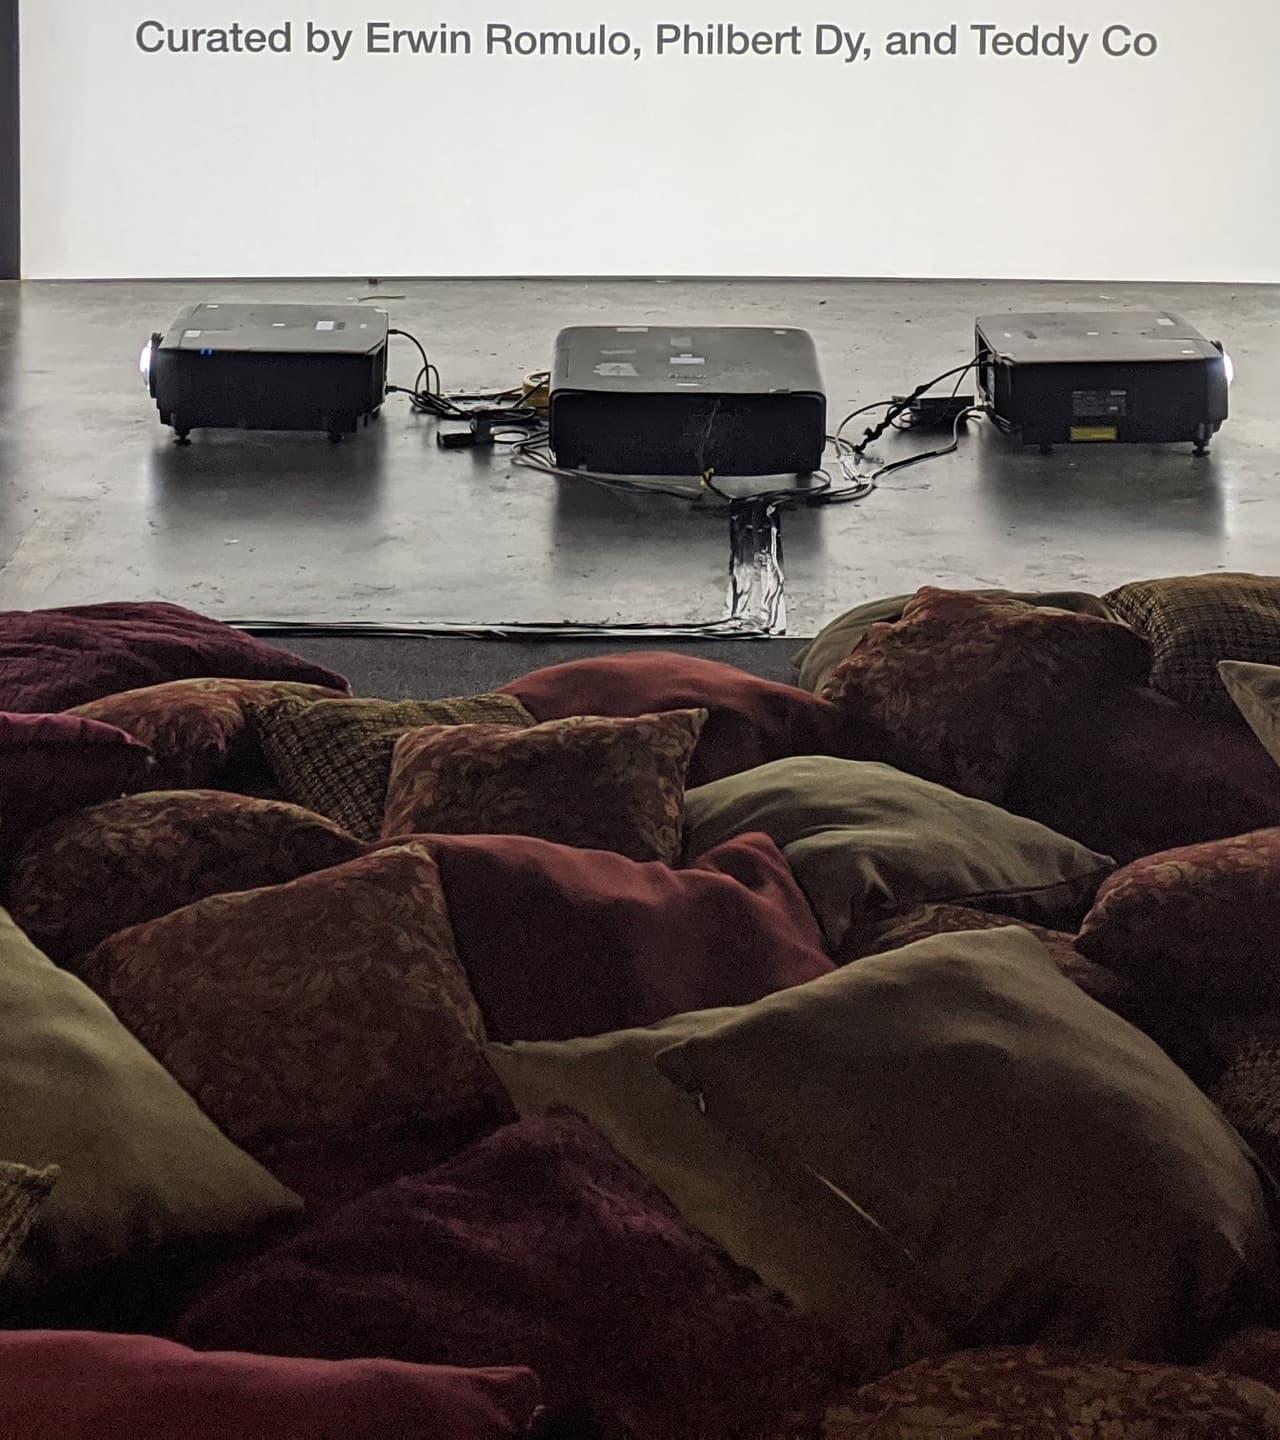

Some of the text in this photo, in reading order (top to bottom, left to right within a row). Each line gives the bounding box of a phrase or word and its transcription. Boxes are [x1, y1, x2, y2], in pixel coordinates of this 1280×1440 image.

[135, 20, 1158, 64] Curated by Erwin Romulo, Philbert Dy, and Teddy Co
